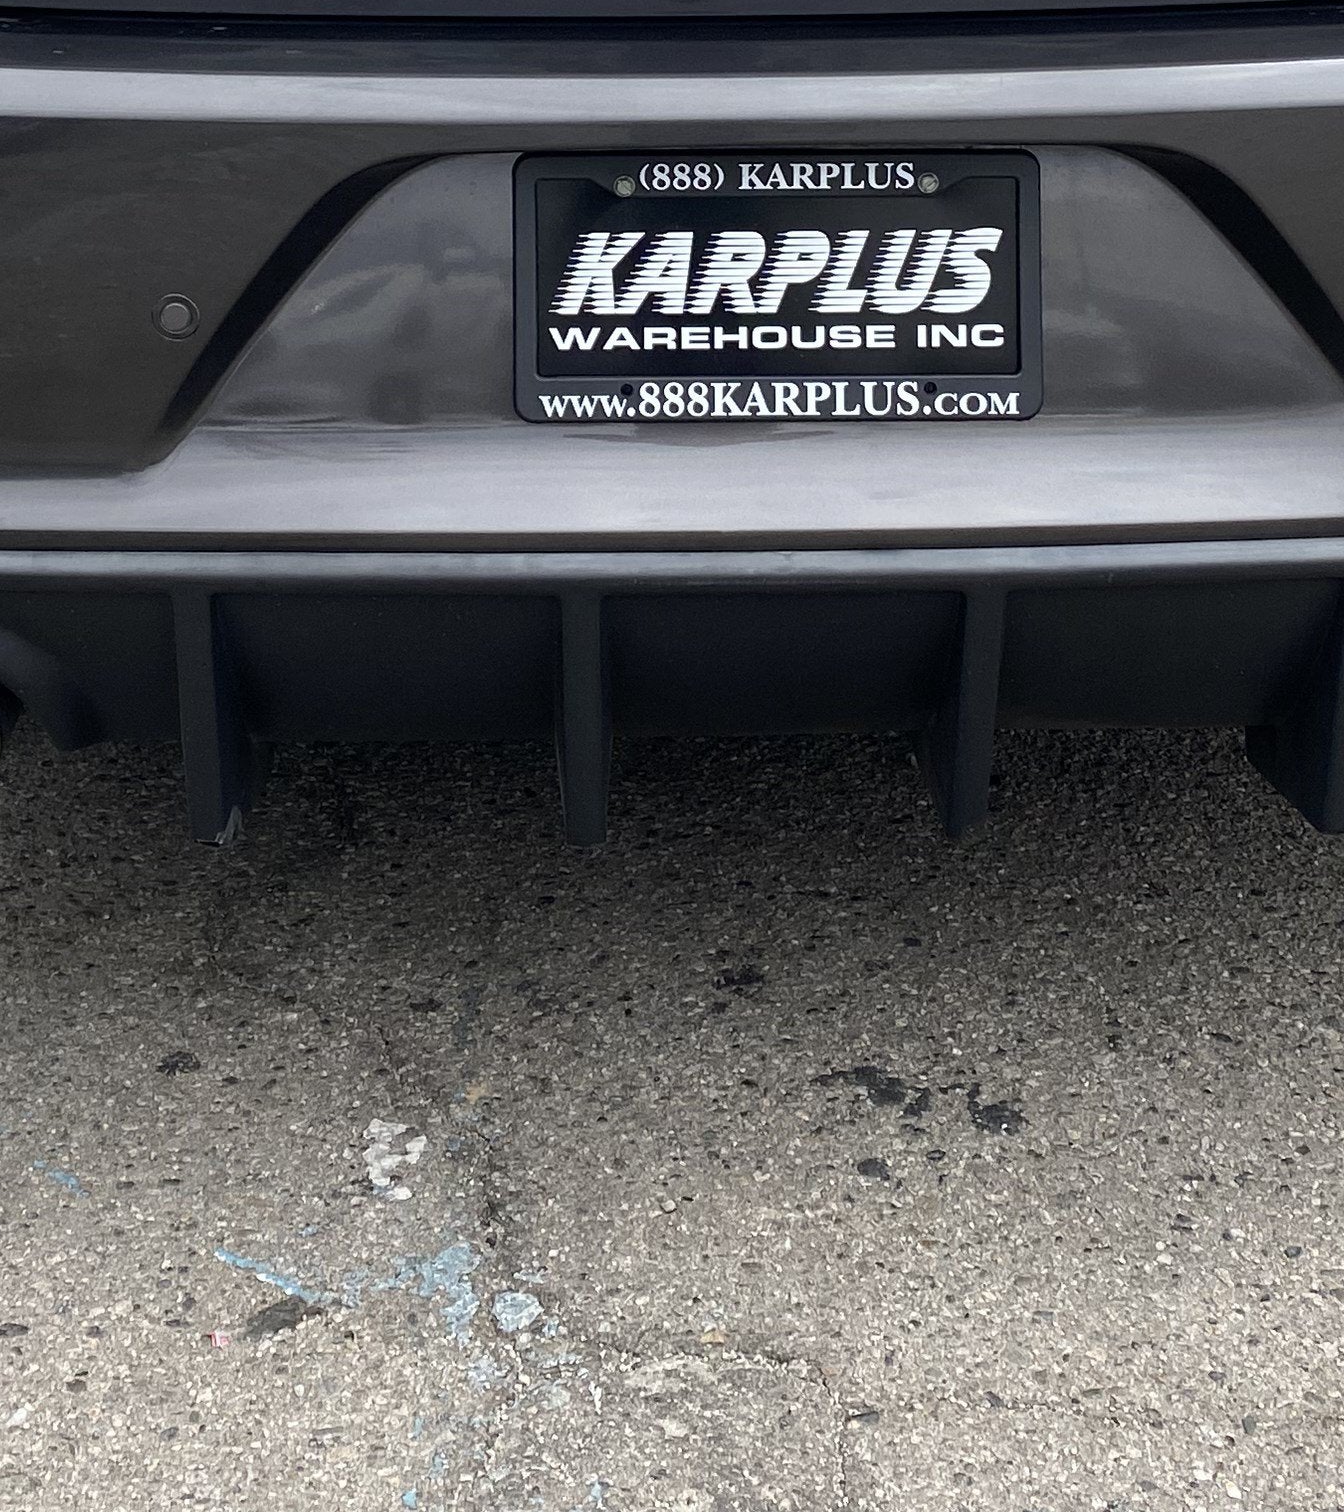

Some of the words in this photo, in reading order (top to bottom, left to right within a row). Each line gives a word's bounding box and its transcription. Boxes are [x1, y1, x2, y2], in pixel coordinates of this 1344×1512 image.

[639, 163, 724, 191] (888)
[738, 162, 915, 190] KARPLUS
[548, 227, 1003, 315] KARPLUS
[548, 324, 896, 350] WAREHOUSE
[916, 323, 1005, 348] INC
